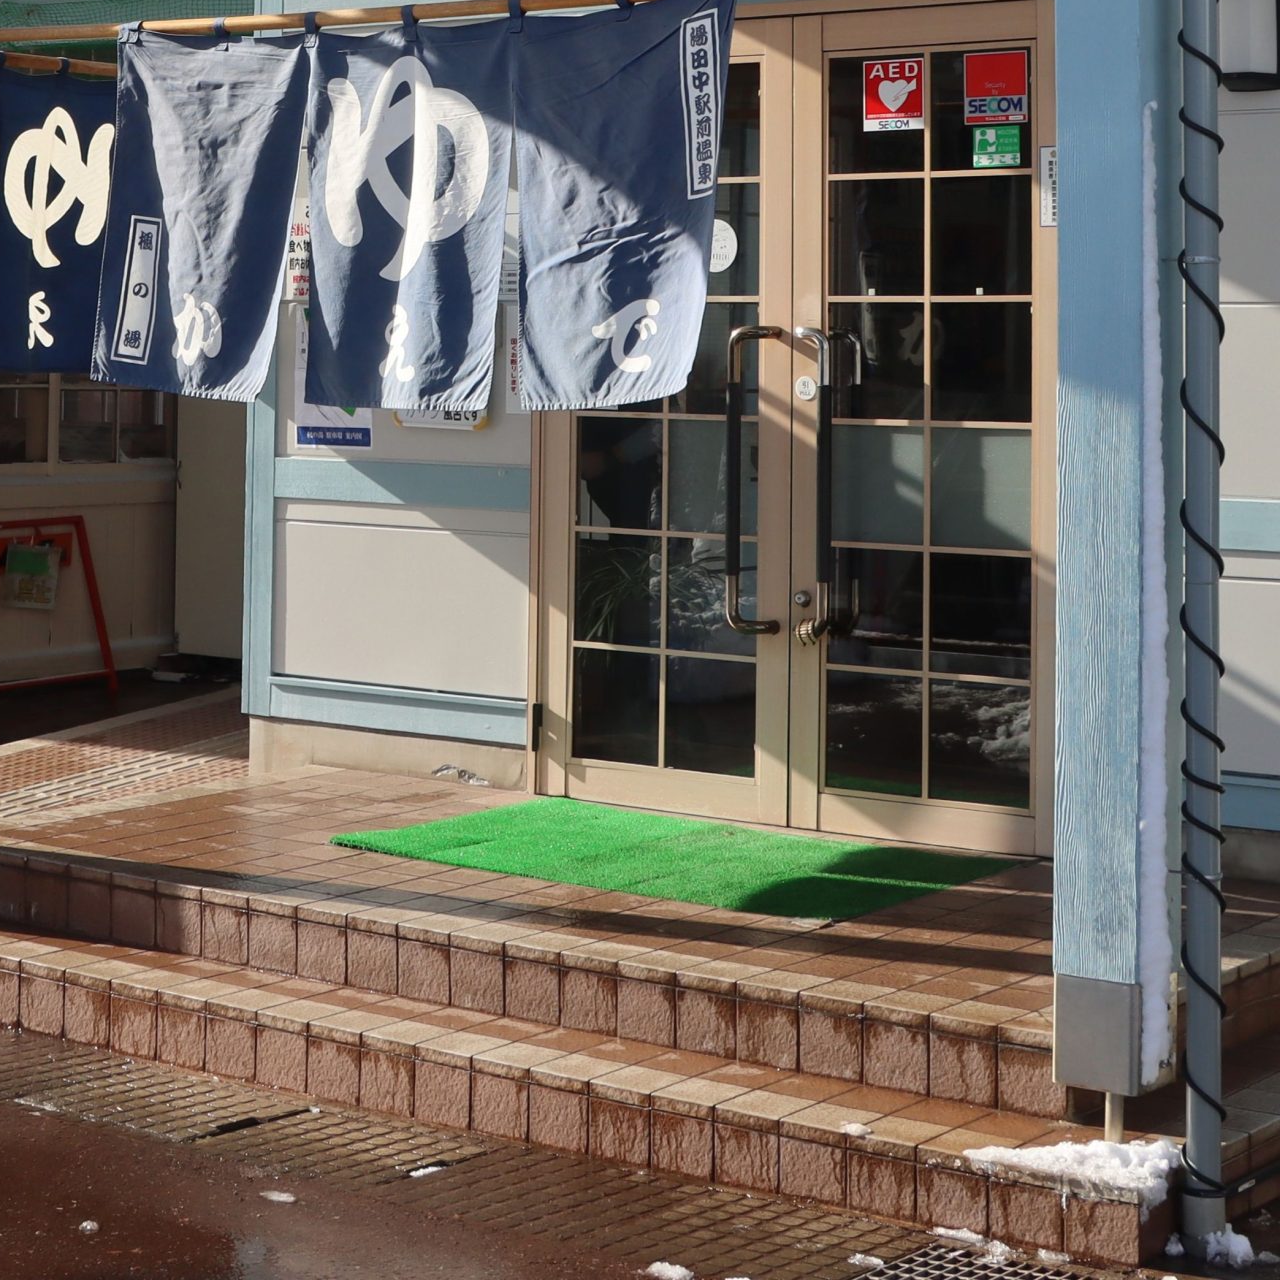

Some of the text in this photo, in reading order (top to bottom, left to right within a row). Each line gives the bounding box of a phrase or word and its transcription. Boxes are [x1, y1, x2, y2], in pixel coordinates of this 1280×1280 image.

[689, 23, 713, 185] 湯田中駅前温泉
[869, 62, 919, 80] AED
[968, 97, 1023, 114] SECOM
[878, 119, 910, 130] SECOM
[324, 55, 490, 282] ゆ
[123, 230, 154, 350] 楓の湯
